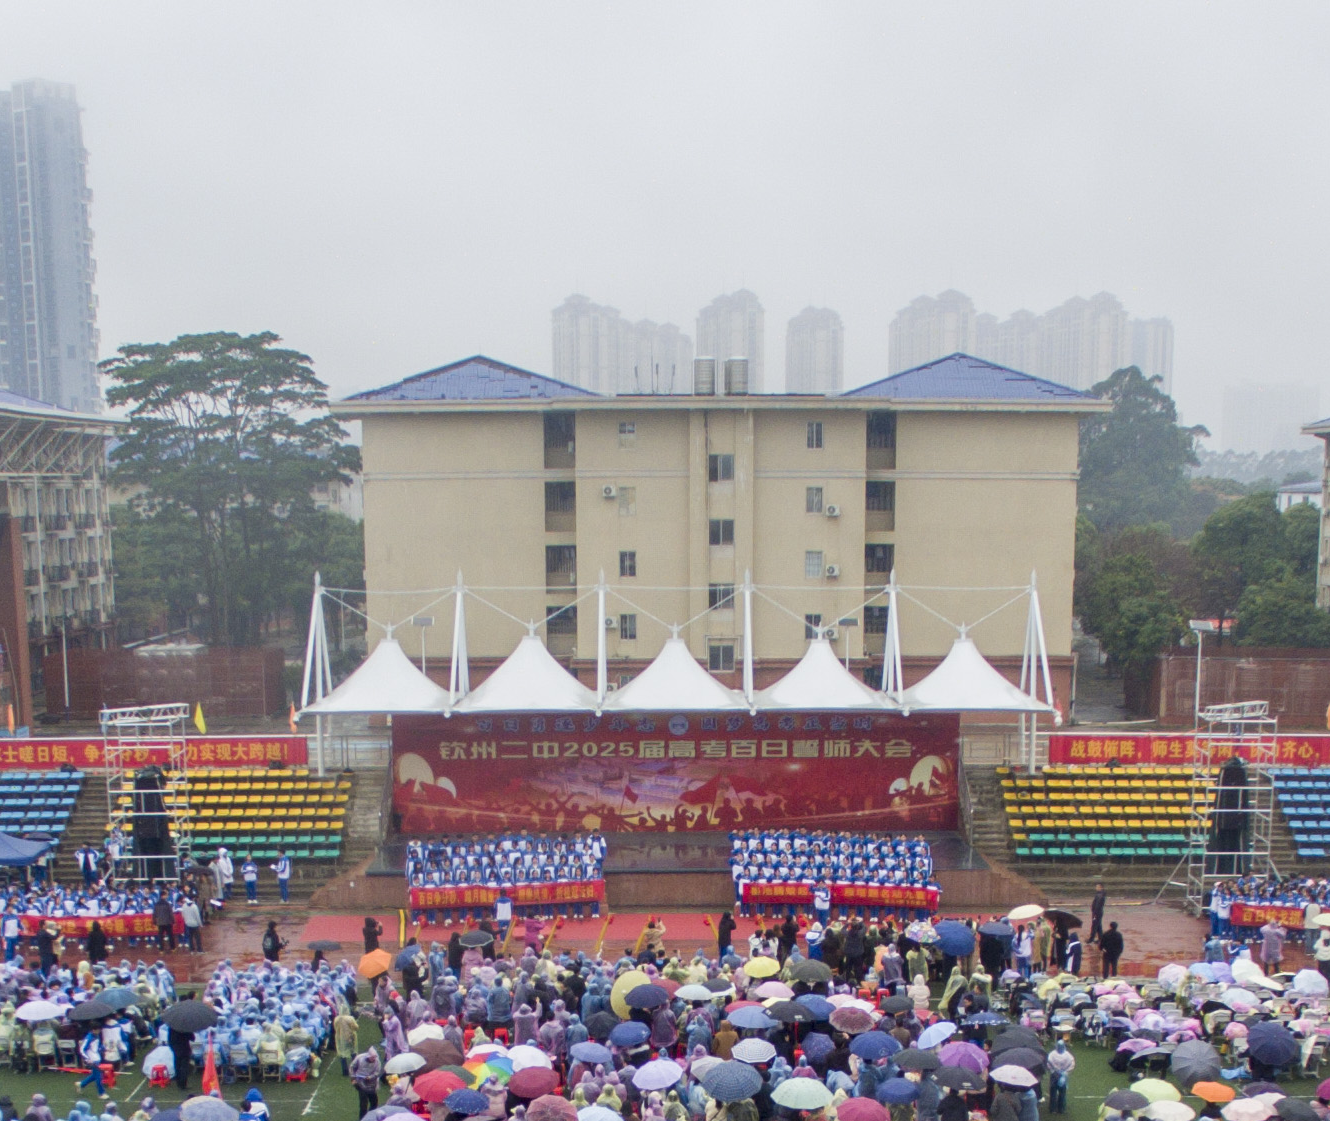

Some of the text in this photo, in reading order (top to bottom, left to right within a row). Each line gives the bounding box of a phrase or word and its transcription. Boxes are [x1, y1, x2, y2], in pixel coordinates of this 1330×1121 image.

[440, 738, 913, 761] 钦州二中2025届高考百日誓师大会
